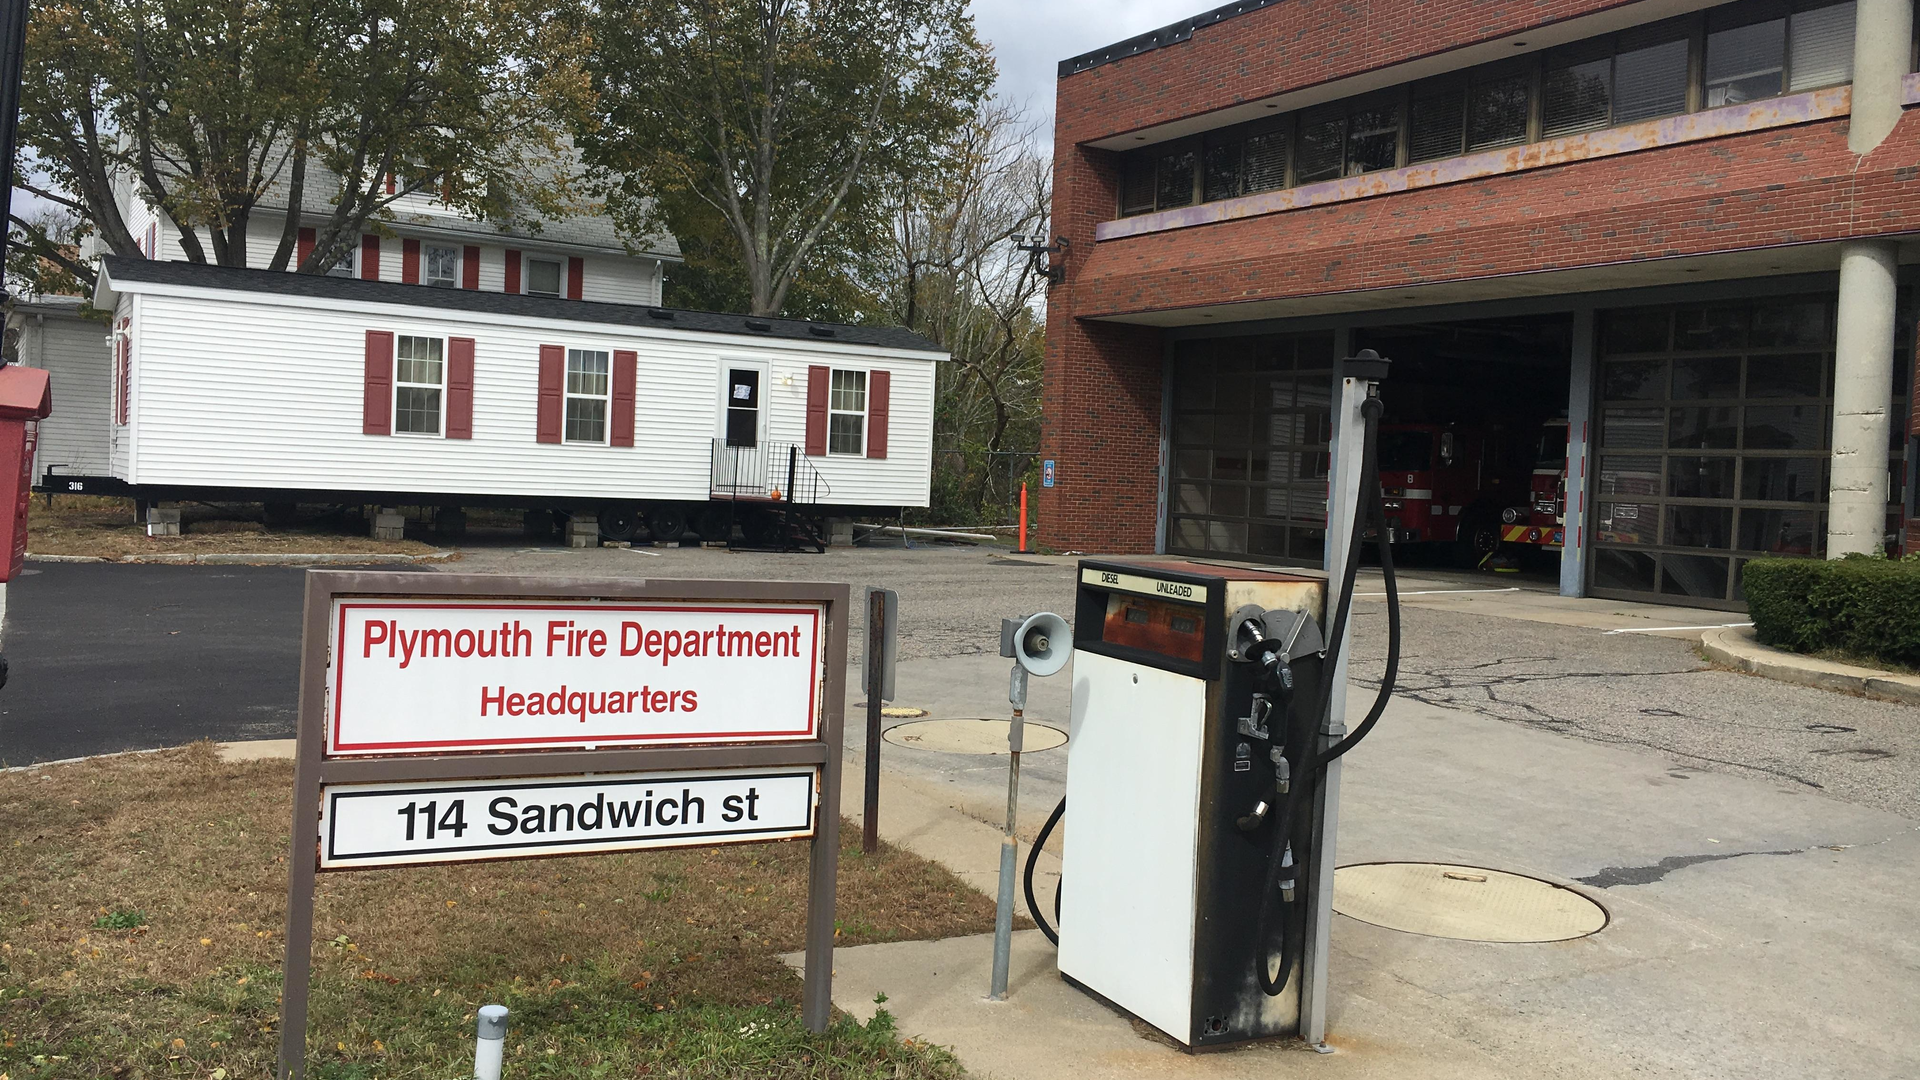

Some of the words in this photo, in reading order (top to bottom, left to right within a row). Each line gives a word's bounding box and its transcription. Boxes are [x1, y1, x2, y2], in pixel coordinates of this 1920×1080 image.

[68, 481, 83, 490] 316
[1101, 572, 1119, 585] DIESEL
[1156, 582, 1192, 598] UNLEADED
[363, 619, 532, 669] Plymouth
[546, 620, 607, 658] Fire
[620, 620, 801, 667] Department
[480, 684, 698, 723] Headquarters
[397, 799, 468, 841] 114
[487, 788, 705, 836] Sandwich
[721, 787, 760, 823] st
